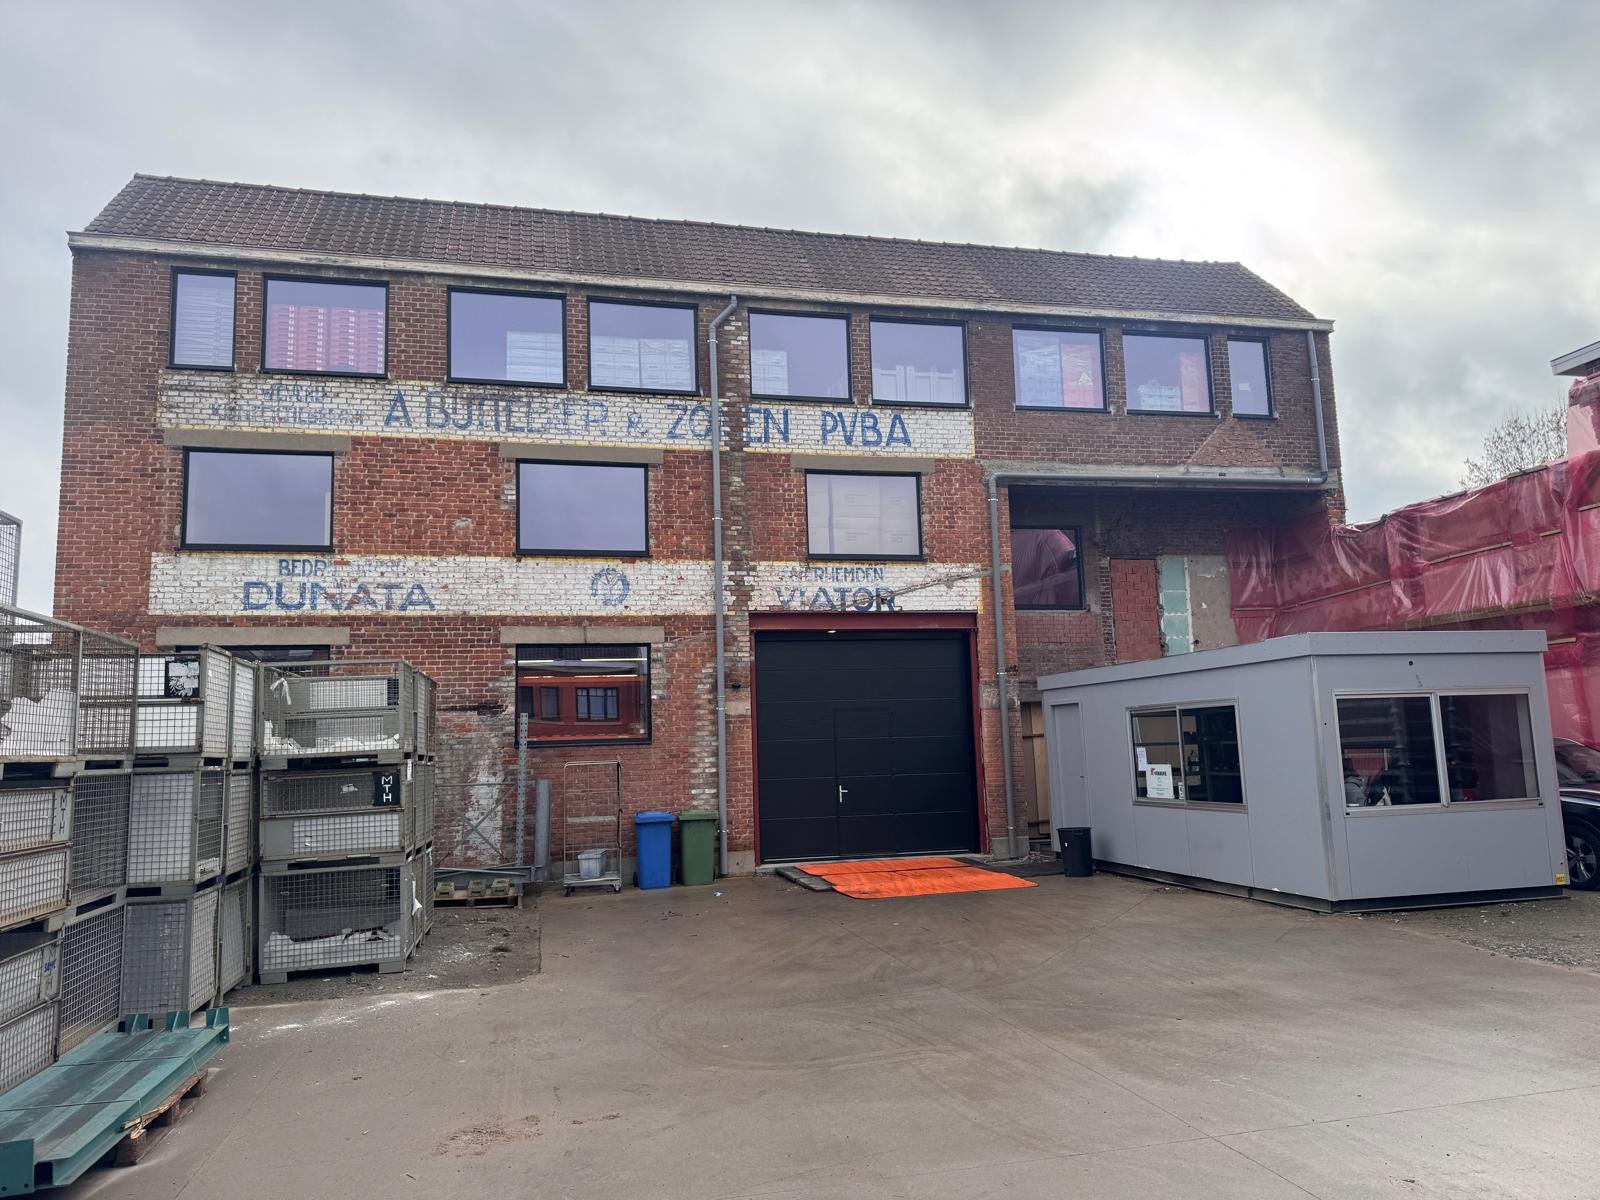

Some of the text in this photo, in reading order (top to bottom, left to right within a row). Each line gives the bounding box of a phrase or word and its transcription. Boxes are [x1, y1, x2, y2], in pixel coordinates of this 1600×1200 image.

[384, 389, 412, 428] A
[666, 403, 790, 443] ZOEN
[821, 410, 912, 447] PVBA
[776, 587, 897, 612] VIATOR
[381, 775, 393, 803] MTH
